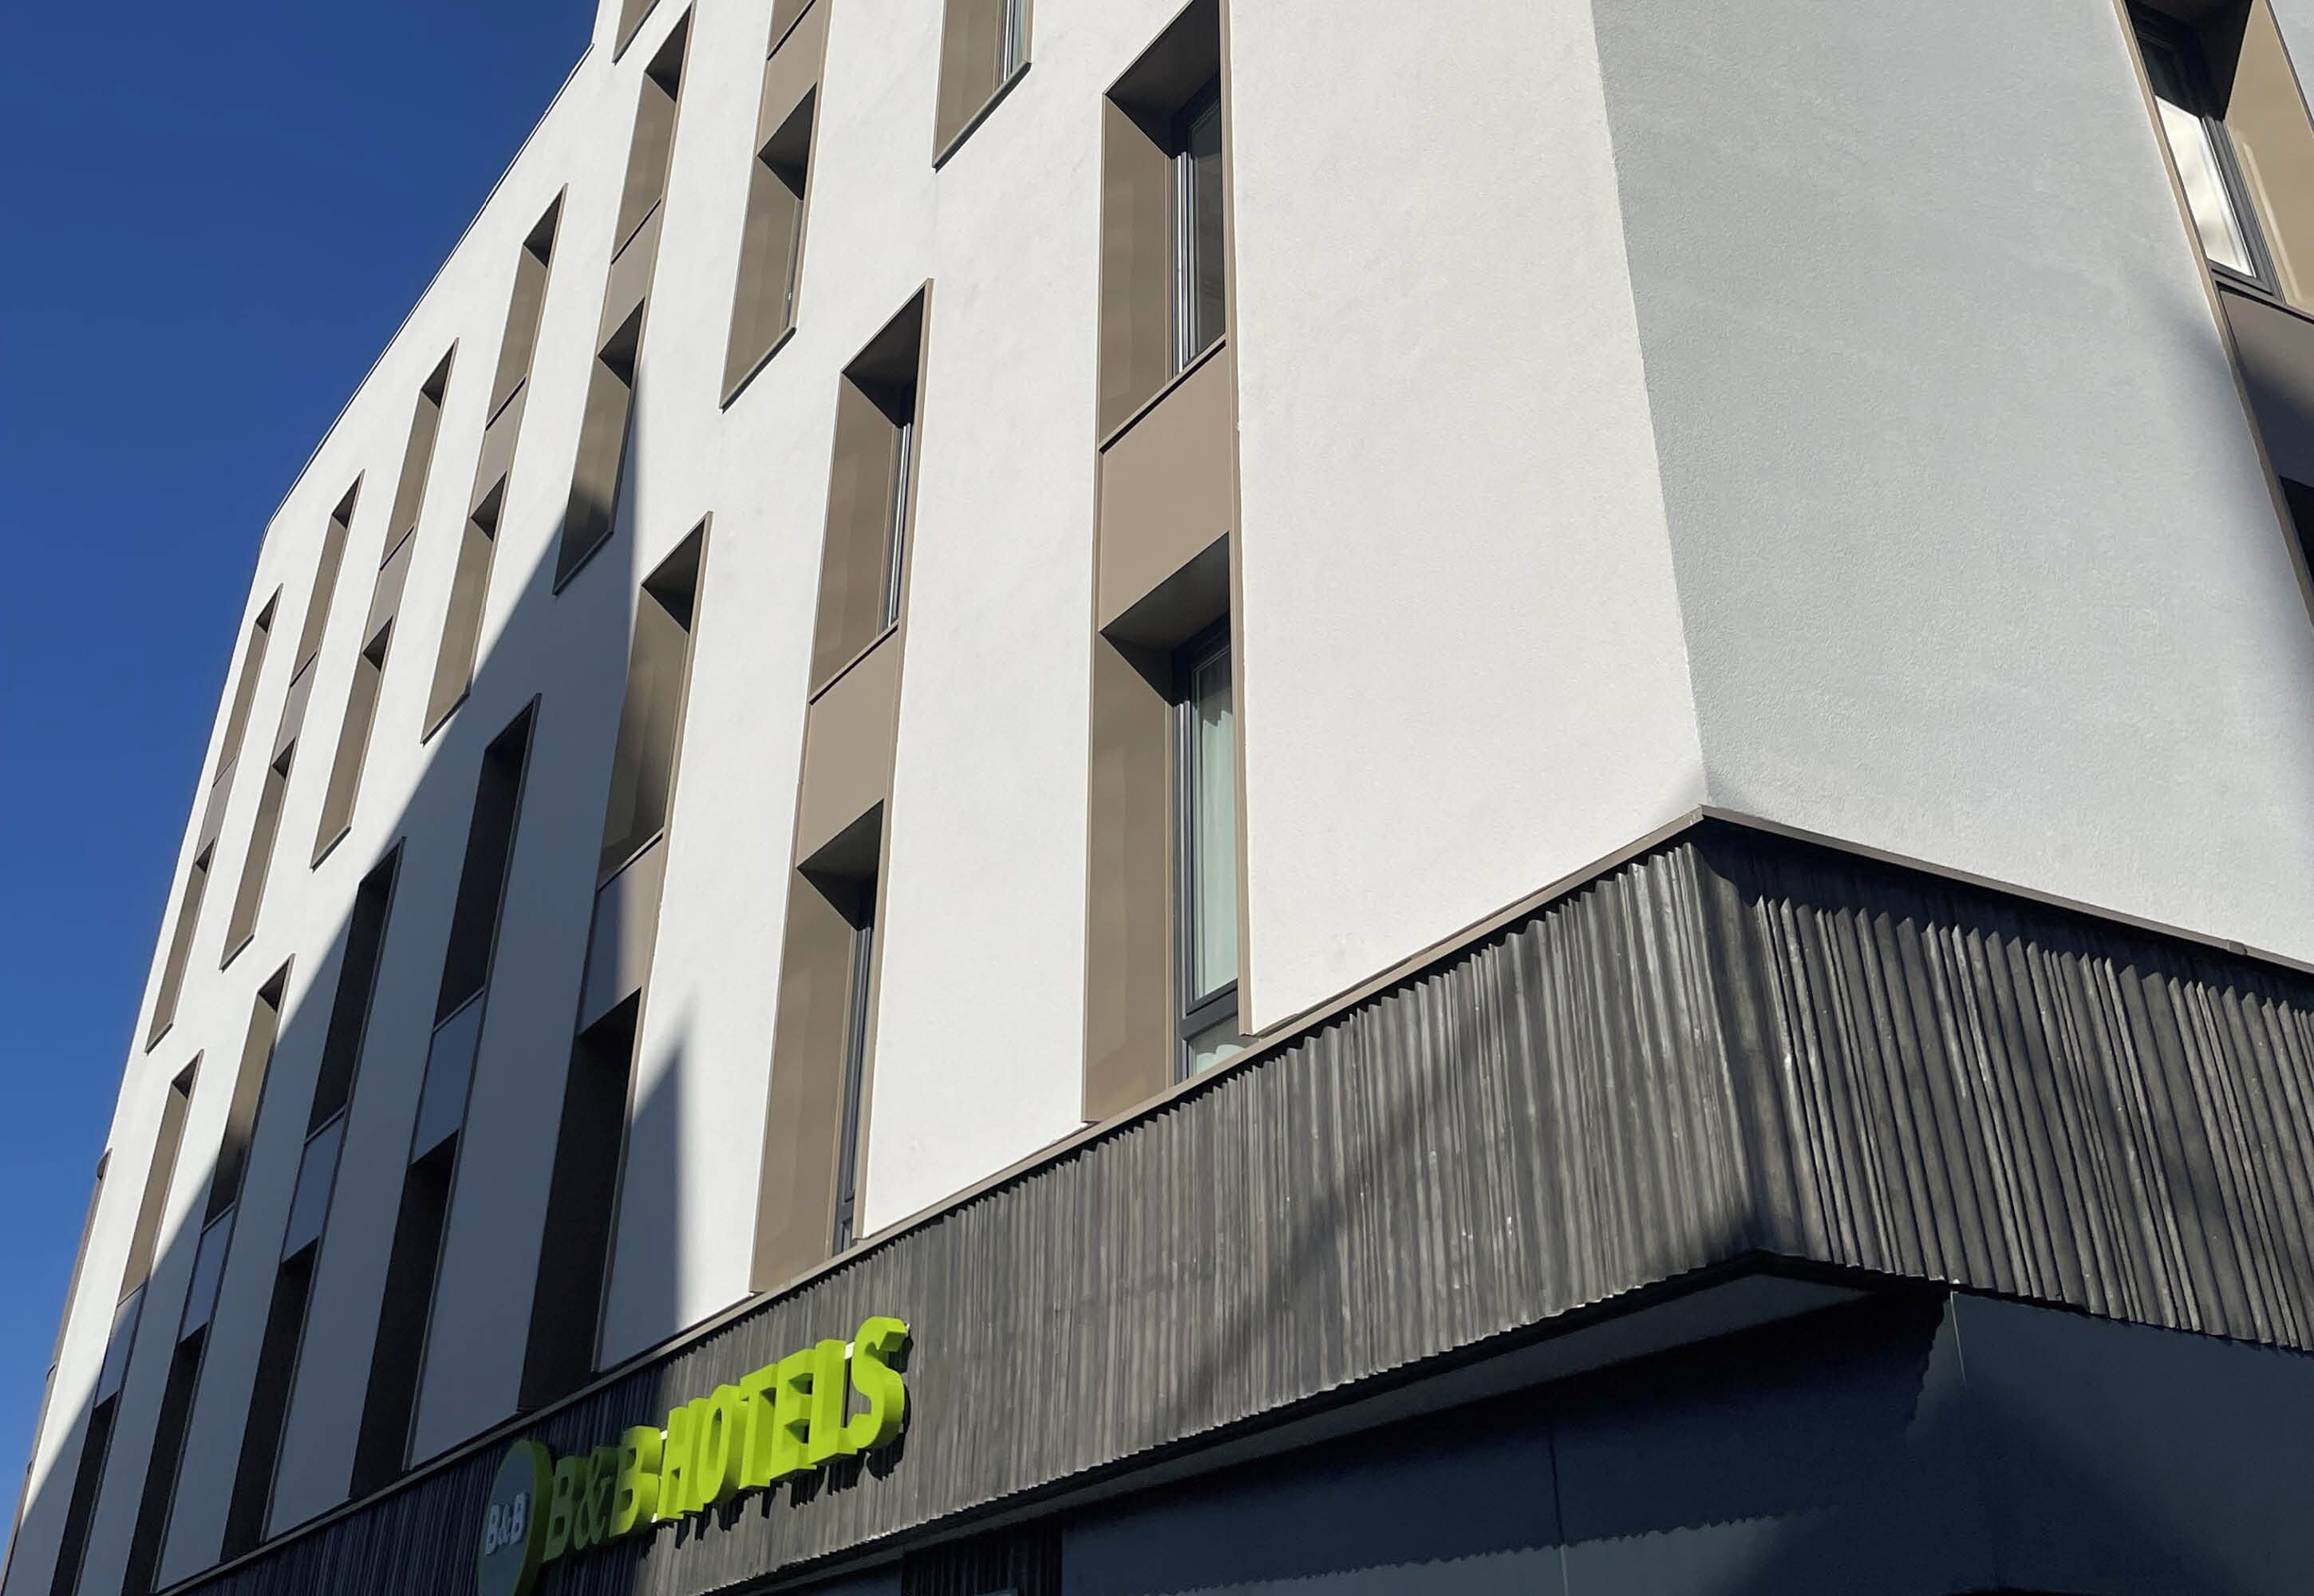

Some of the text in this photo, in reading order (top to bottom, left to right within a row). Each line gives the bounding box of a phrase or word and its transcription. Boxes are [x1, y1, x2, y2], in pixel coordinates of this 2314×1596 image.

[543, 1316, 906, 1562] B&B HOTELS
[485, 1492, 530, 1555] B&B
